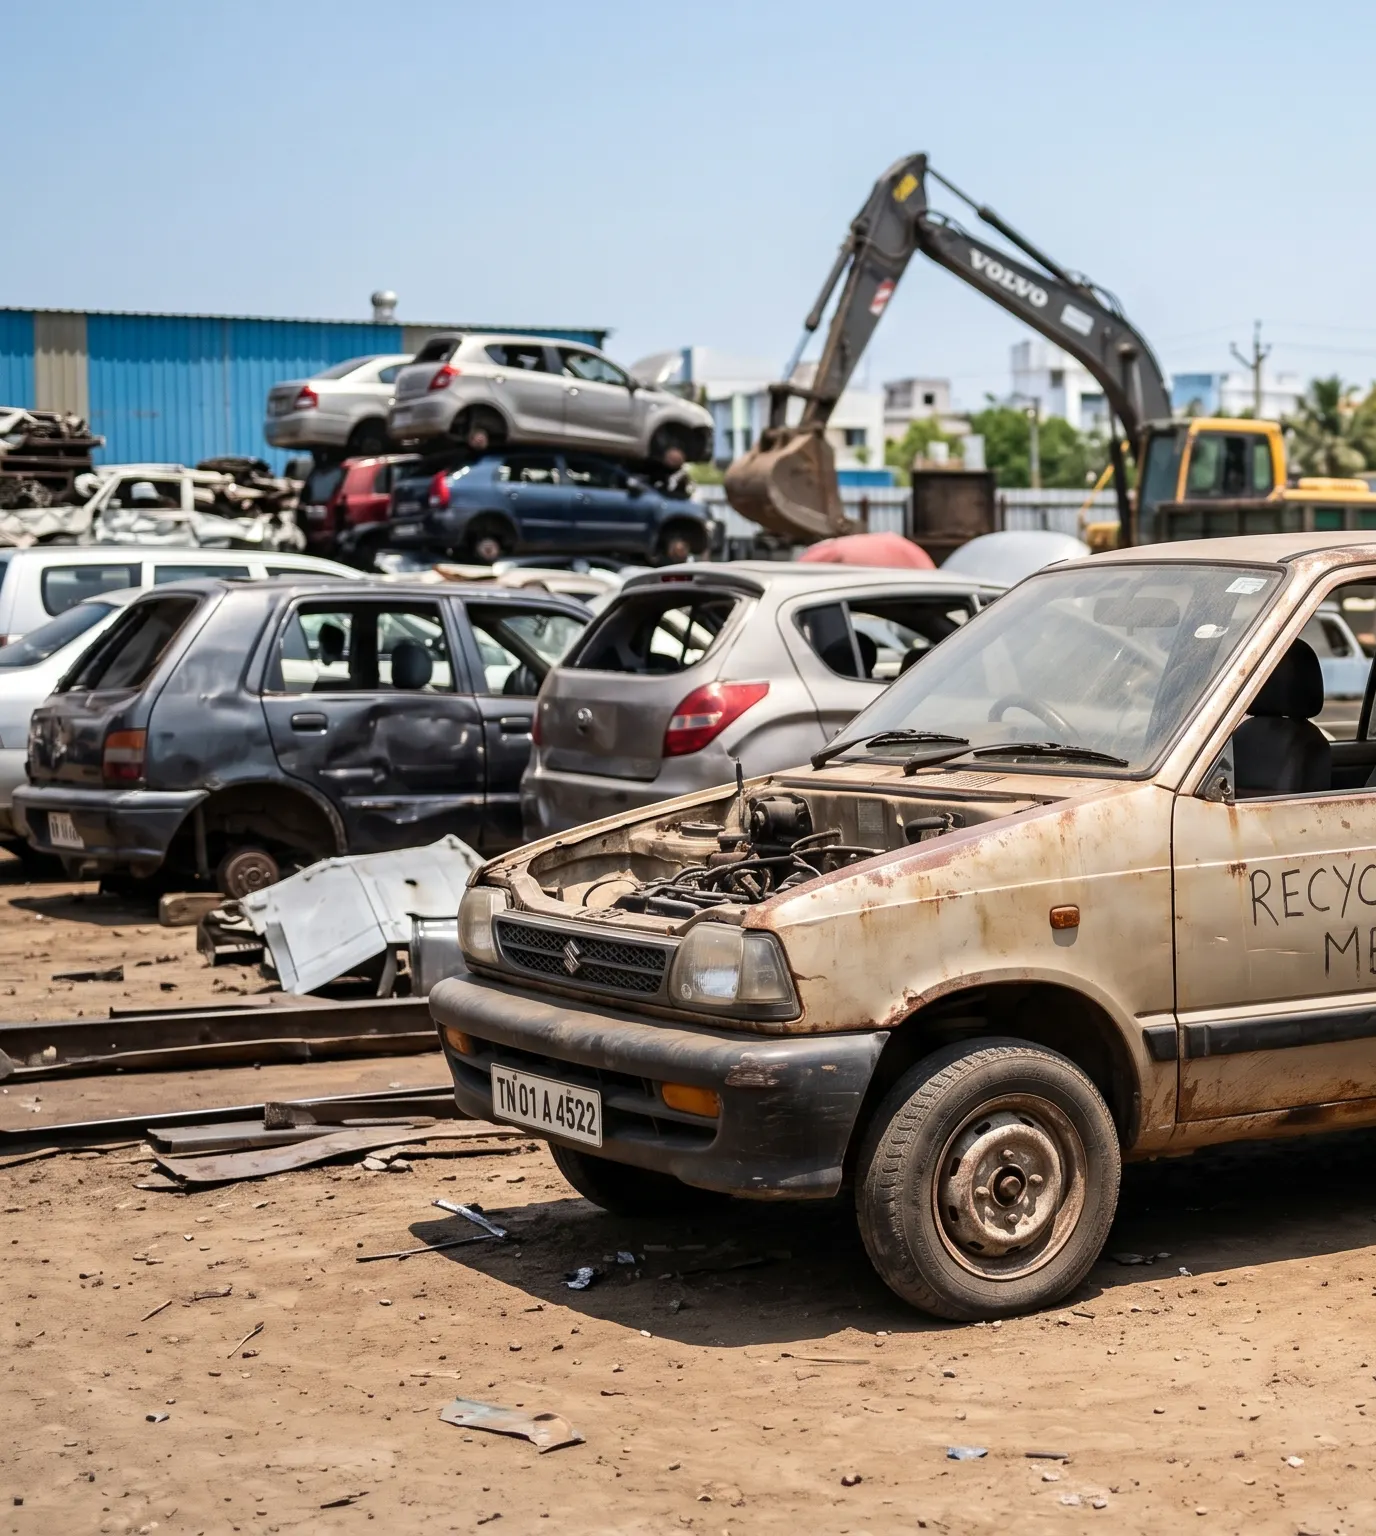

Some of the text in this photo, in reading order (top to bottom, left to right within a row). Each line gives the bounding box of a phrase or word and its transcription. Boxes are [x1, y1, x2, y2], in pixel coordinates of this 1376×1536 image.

[969, 247, 1048, 307] VOLVO
[543, 1090, 552, 1124] A
[556, 1095, 596, 1136] 4522
